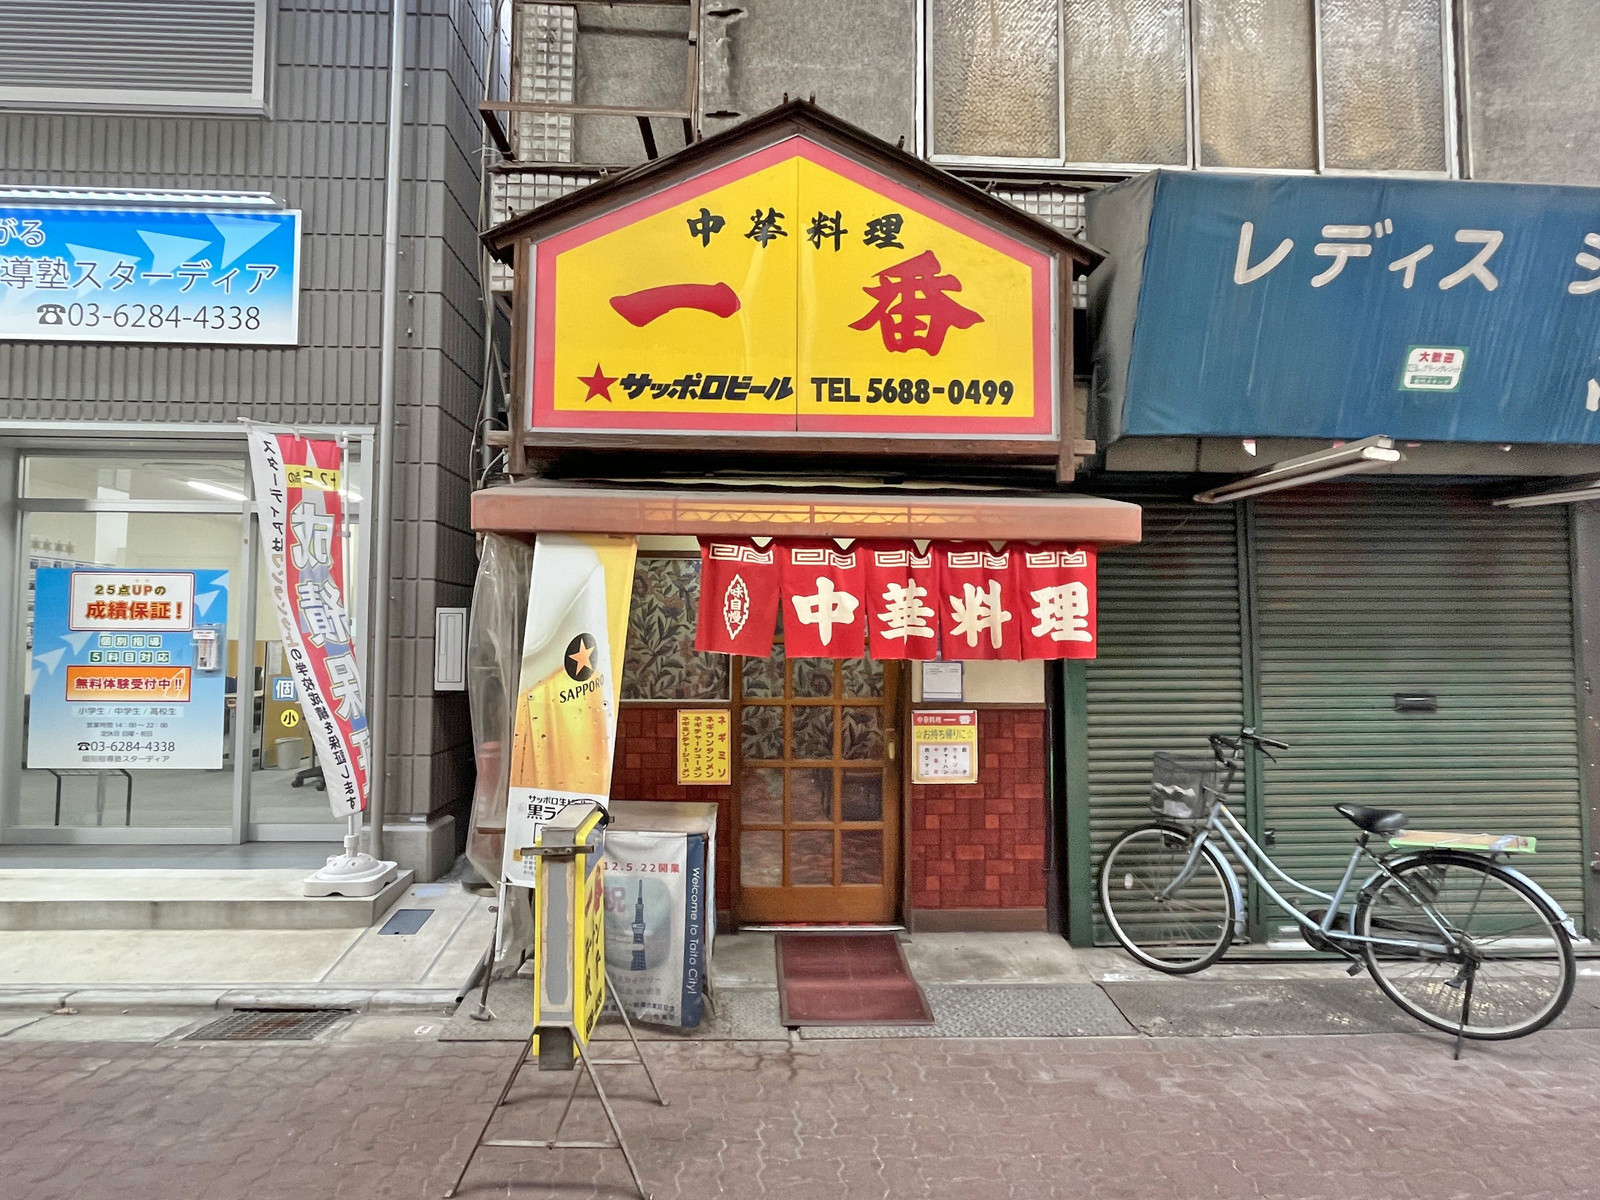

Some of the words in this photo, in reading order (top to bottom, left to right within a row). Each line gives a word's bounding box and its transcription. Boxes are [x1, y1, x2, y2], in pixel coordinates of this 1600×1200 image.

[687, 208, 905, 251] 中華料理
[1234, 218, 1504, 291] レディス
[0, 257, 278, 294] 導塾スターディア
[67, 302, 261, 331] 03-6284-4338
[609, 250, 985, 356] 一番
[619, 372, 794, 400] サッポロビール
[811, 378, 860, 403] TEL
[866, 376, 1014, 406] 5688-0499
[791, 576, 1093, 649] 中華料理
[559, 674, 605, 704] SAPPORO
[283, 711, 297, 725] 小
[91, 741, 175, 752] 03-6284-4338
[706, 715, 714, 778] ネギワンタンメン
[718, 715, 727, 778] ネギミソ
[528, 794, 572, 807] サッポロ生
[690, 867, 700, 920] Welcome
[689, 924, 699, 935] to
[688, 938, 699, 965] Taito
